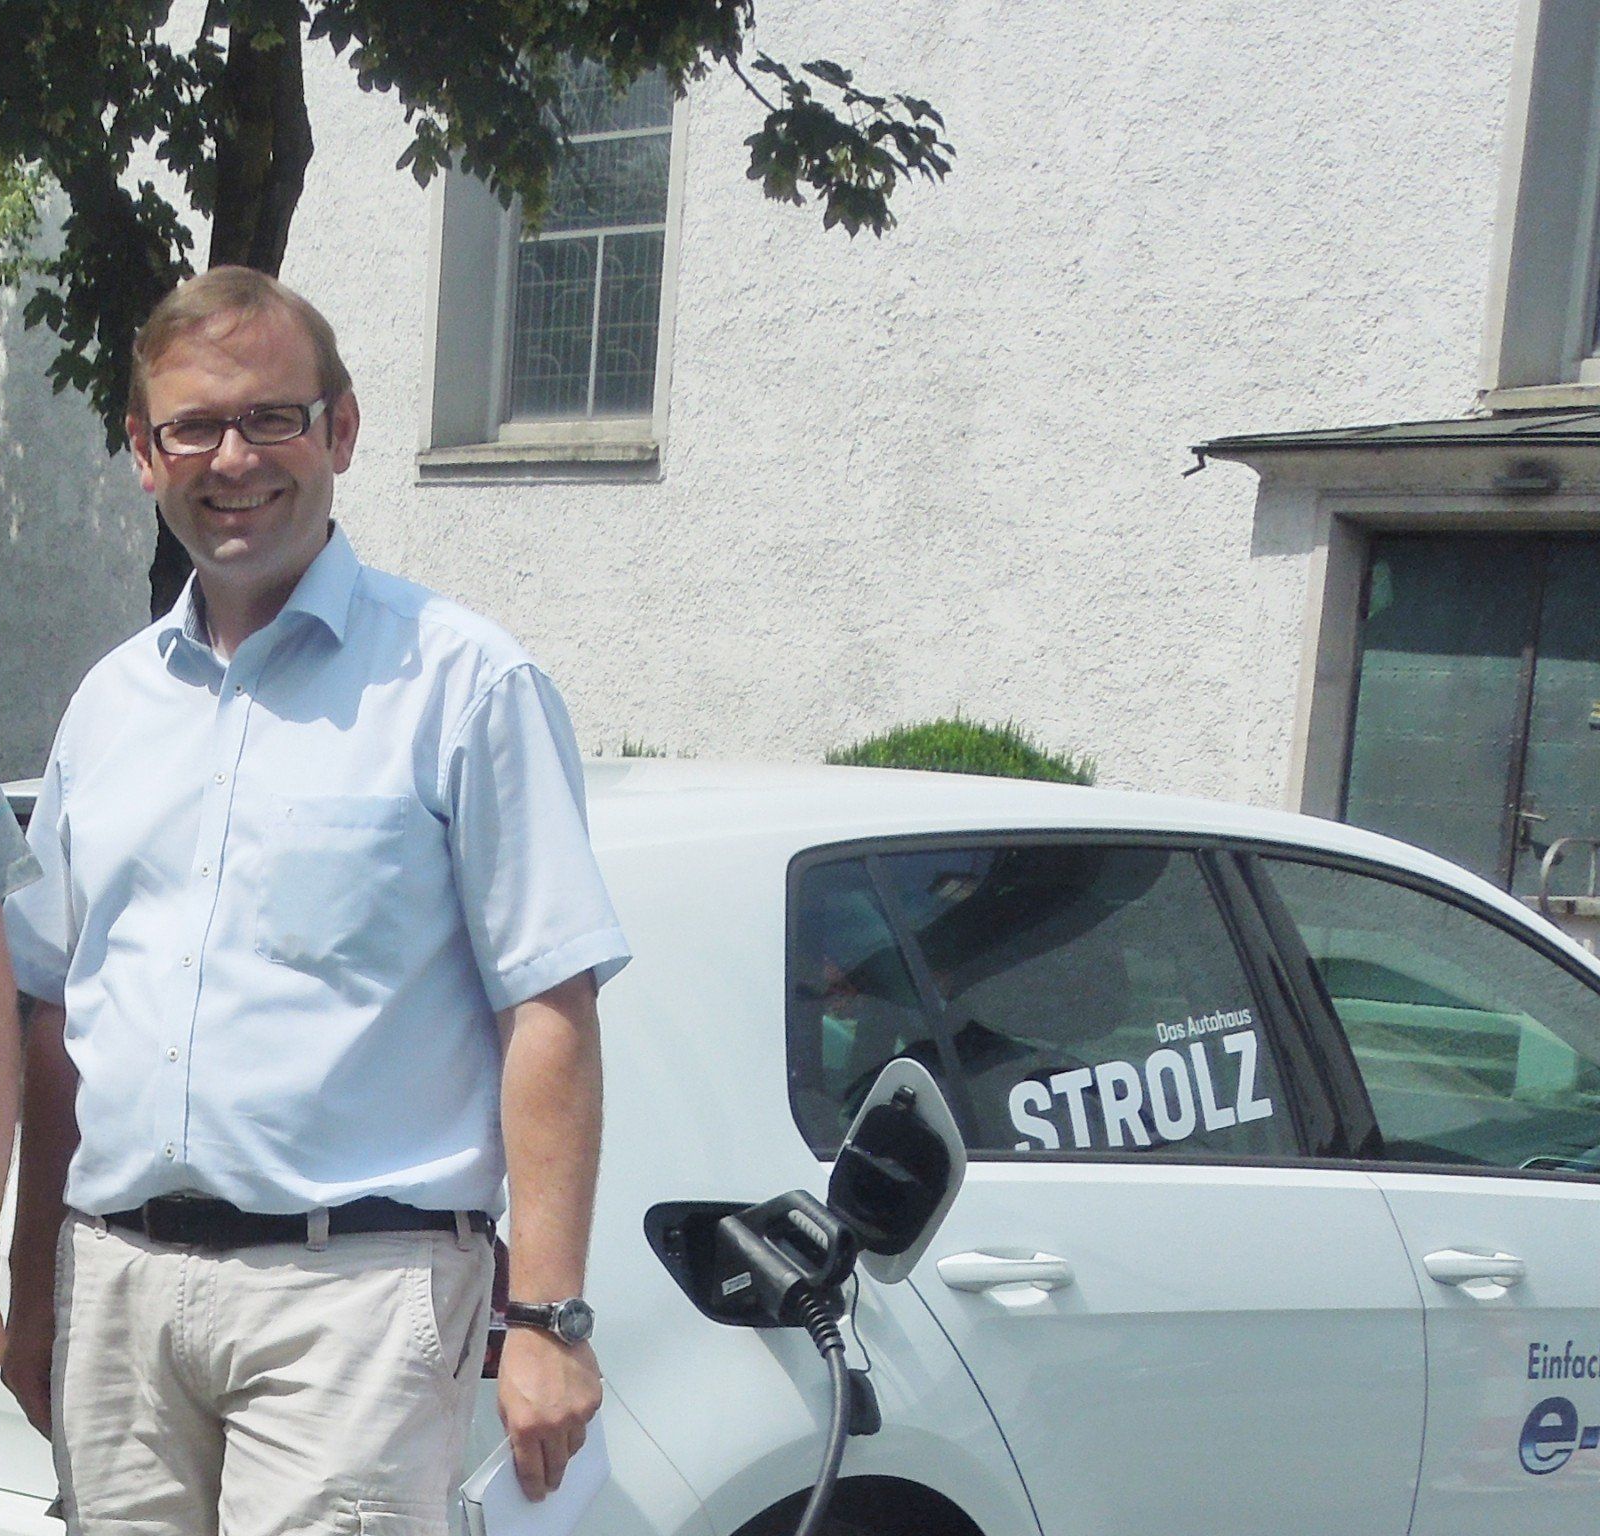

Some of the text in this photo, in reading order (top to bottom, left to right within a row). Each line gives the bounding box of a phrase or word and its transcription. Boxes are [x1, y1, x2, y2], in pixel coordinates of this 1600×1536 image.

[1156, 1007, 1252, 1044] Das Autohaus
[1008, 1030, 1273, 1151] STROLZ
[1527, 1340, 1600, 1380] Einfac
